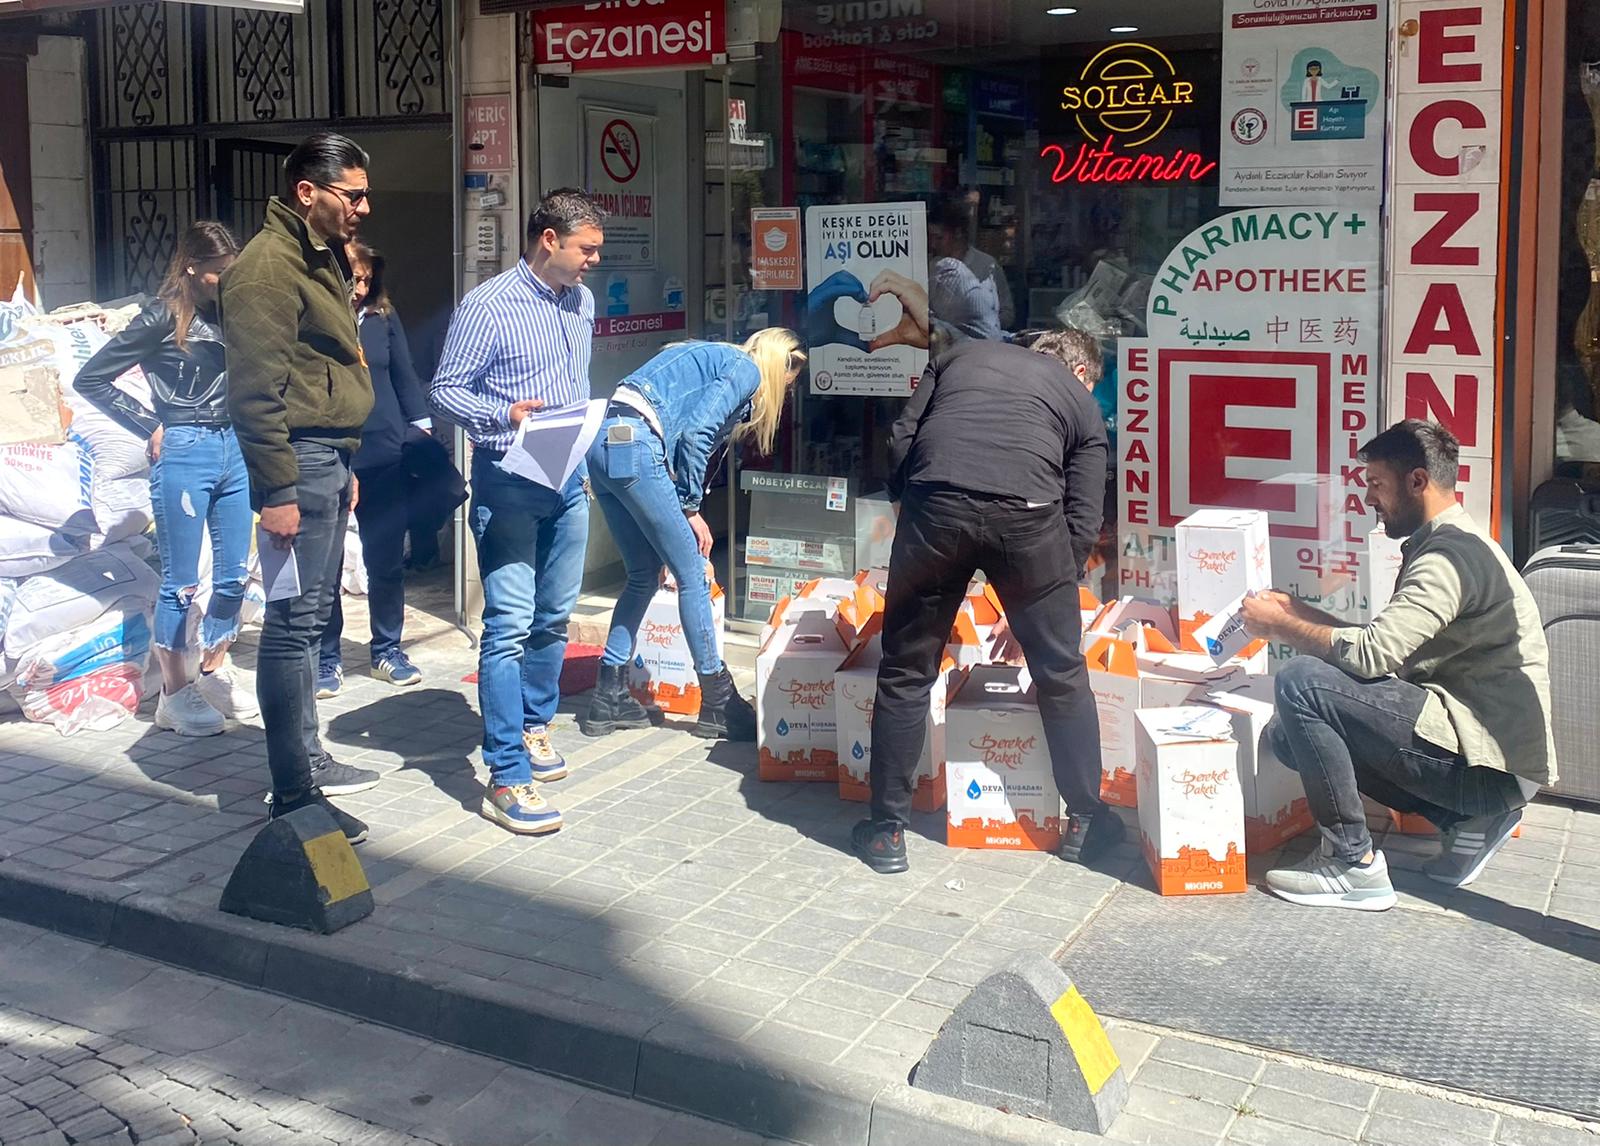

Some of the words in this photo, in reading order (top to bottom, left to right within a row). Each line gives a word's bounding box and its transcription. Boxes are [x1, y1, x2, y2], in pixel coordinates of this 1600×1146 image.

[1237, 12, 1318, 25] Sorumluluğumuzun
[1319, 8, 1373, 20] Farkındayız
[545, 10, 712, 61] Eczanesi
[1061, 82, 1194, 110] SOLGAR
[467, 103, 506, 126] MERİÇ
[1298, 111, 1314, 129] E
[471, 130, 502, 145] APT.
[1041, 135, 1217, 183] Vitamin
[822, 214, 862, 230] KEŞKE
[868, 211, 909, 227] DEĞİL
[852, 229, 883, 239] DEMEK
[888, 228, 909, 240] İÇİN
[824, 240, 852, 264] AŞI
[857, 239, 909, 258] OLUN
[1403, 7, 1488, 507] ECZAN
[1191, 268, 1367, 293] APOTHEKE
[609, 314, 663, 333] Eczanesi
[1179, 317, 1251, 346] صيدلية
[1266, 315, 1360, 346] 中医药
[1125, 348, 1150, 525] ECZANE
[1189, 374, 1297, 512] E
[1340, 353, 1368, 543] MEDİKAL
[1218, 625, 1238, 642] DEVA
[790, 693, 825, 710] Paketi
[789, 722, 808, 730] DEVA
[969, 732, 1038, 755] Bereket
[983, 750, 1024, 769] Paketi
[1172, 768, 1230, 785] Bereket
[1182, 783, 1218, 799] Paketi
